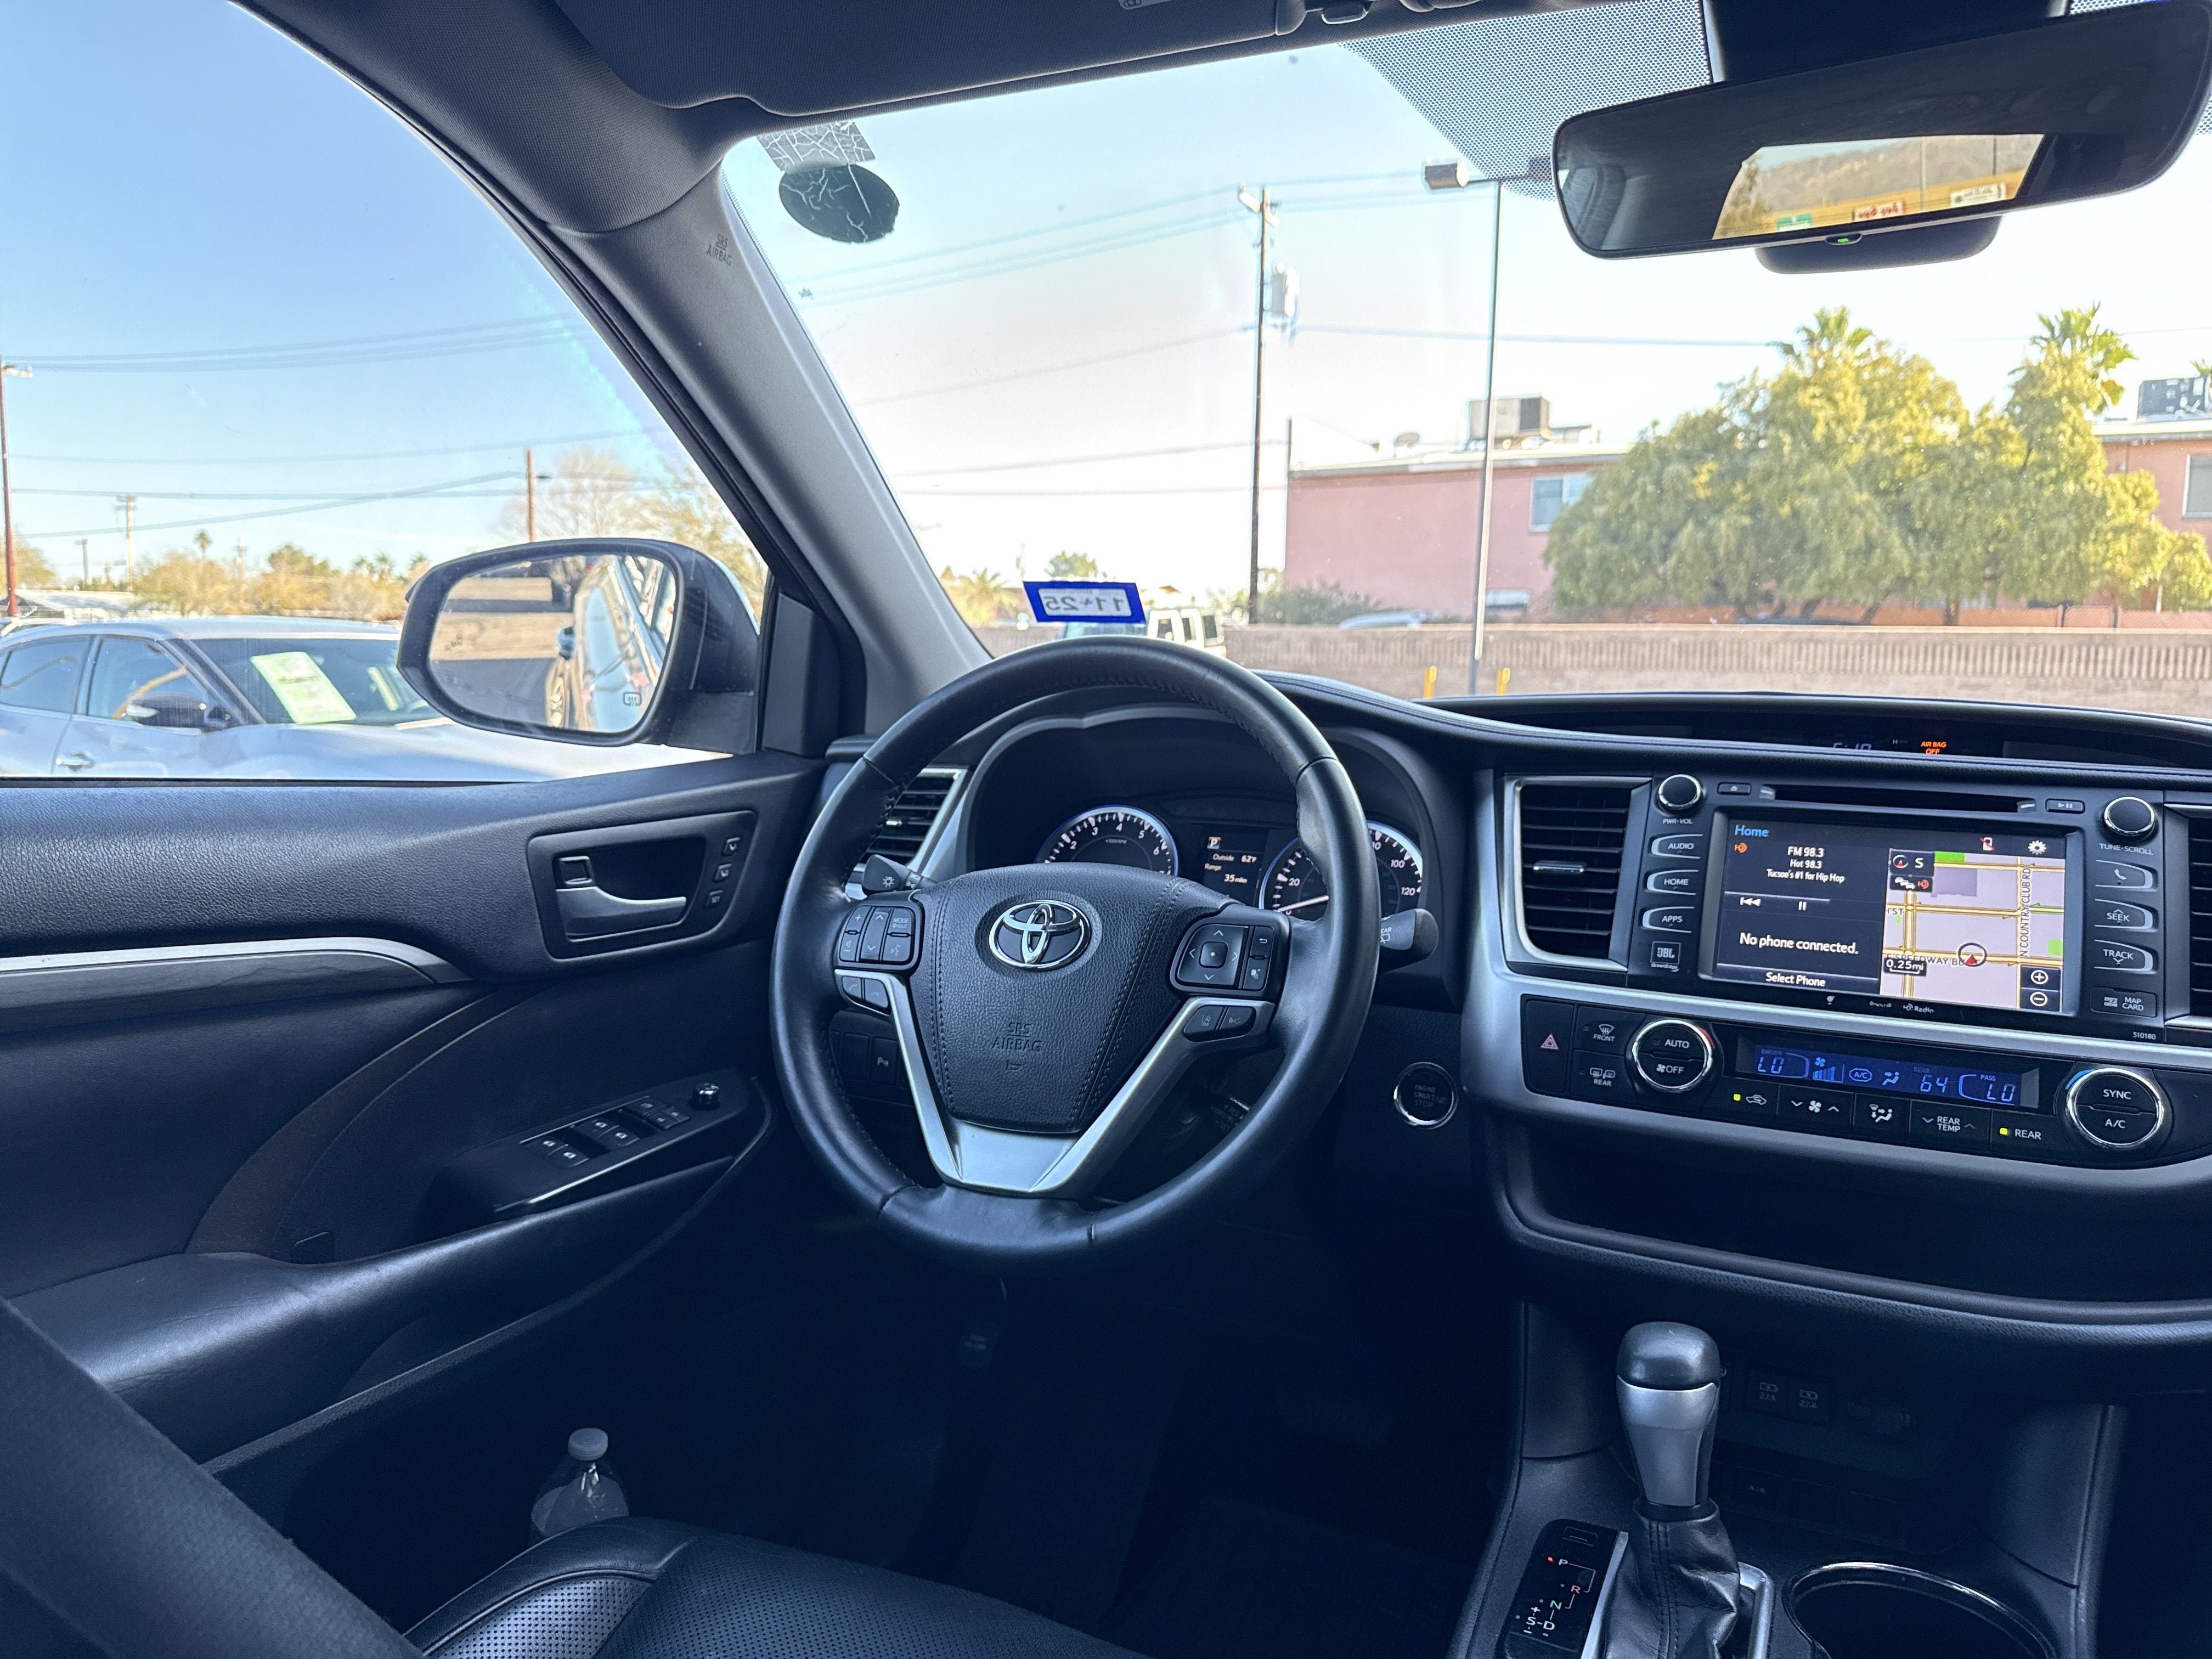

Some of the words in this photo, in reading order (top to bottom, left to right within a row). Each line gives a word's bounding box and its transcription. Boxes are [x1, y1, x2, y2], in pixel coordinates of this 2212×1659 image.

[716, 234, 728, 248] SRS
[706, 245, 732, 266] AIRBAG
[1092, 827, 1098, 836] 3
[1116, 823, 1122, 831] 4
[1735, 825, 1769, 837] Home
[1138, 830, 1144, 838] 5
[1070, 840, 1077, 849] 2
[1787, 846, 1802, 856] FM
[1803, 848, 1824, 857] 98.3
[1391, 859, 1405, 868] 100
[1790, 859, 1803, 868] Hot
[1805, 860, 1822, 869] 98.3
[1915, 857, 1923, 868] S
[1767, 869, 1793, 879] Tucson's
[1795, 871, 1803, 879] #1
[1805, 872, 1814, 881] for
[1815, 873, 1827, 882] Hip
[1829, 874, 1845, 883] Hop
[2023, 867, 2031, 878] RD
[1289, 878, 1300, 887] 20
[1401, 887, 1415, 896] 120
[2022, 881, 2031, 904] CLUB
[1662, 915, 1683, 923] APPS
[2107, 912, 2129, 922] SEEK
[2020, 906, 2030, 949] COUNTRY
[1740, 933, 1757, 946] No
[1759, 934, 1793, 950] phone
[1796, 938, 1859, 955] connected.
[1657, 947, 1675, 958] JBL
[2103, 949, 2134, 961] TRACK
[1886, 959, 1924, 971] 0.25mi
[1765, 973, 1793, 984] Select
[1796, 975, 1826, 987] Phone
[2125, 996, 2142, 1005] MAP
[2123, 1003, 2144, 1011] CARD
[1007, 1022, 1032, 1036] SRS
[1593, 1033, 1615, 1042] FRONT
[2132, 1031, 2157, 1040] 510180
[992, 1036, 1042, 1053] AIRBAG
[1664, 1039, 1690, 1049] AUTO
[1666, 1065, 1685, 1074] OFF
[1854, 1071, 1869, 1079] A/C
[1593, 1078, 1612, 1087] REAR
[1920, 1074, 1949, 1093] 64
[2103, 1089, 2131, 1100] SYNC
[1937, 1116, 1960, 1125] REAR
[2104, 1118, 2126, 1129] A/C
[1938, 1123, 1961, 1133] TEMP
[2015, 1129, 2042, 1141] REAR
[1570, 1585, 1581, 1594] R
[1549, 1600, 1562, 1610] N
[1526, 1616, 1537, 1626] S
[1542, 1620, 1555, 1631] D
